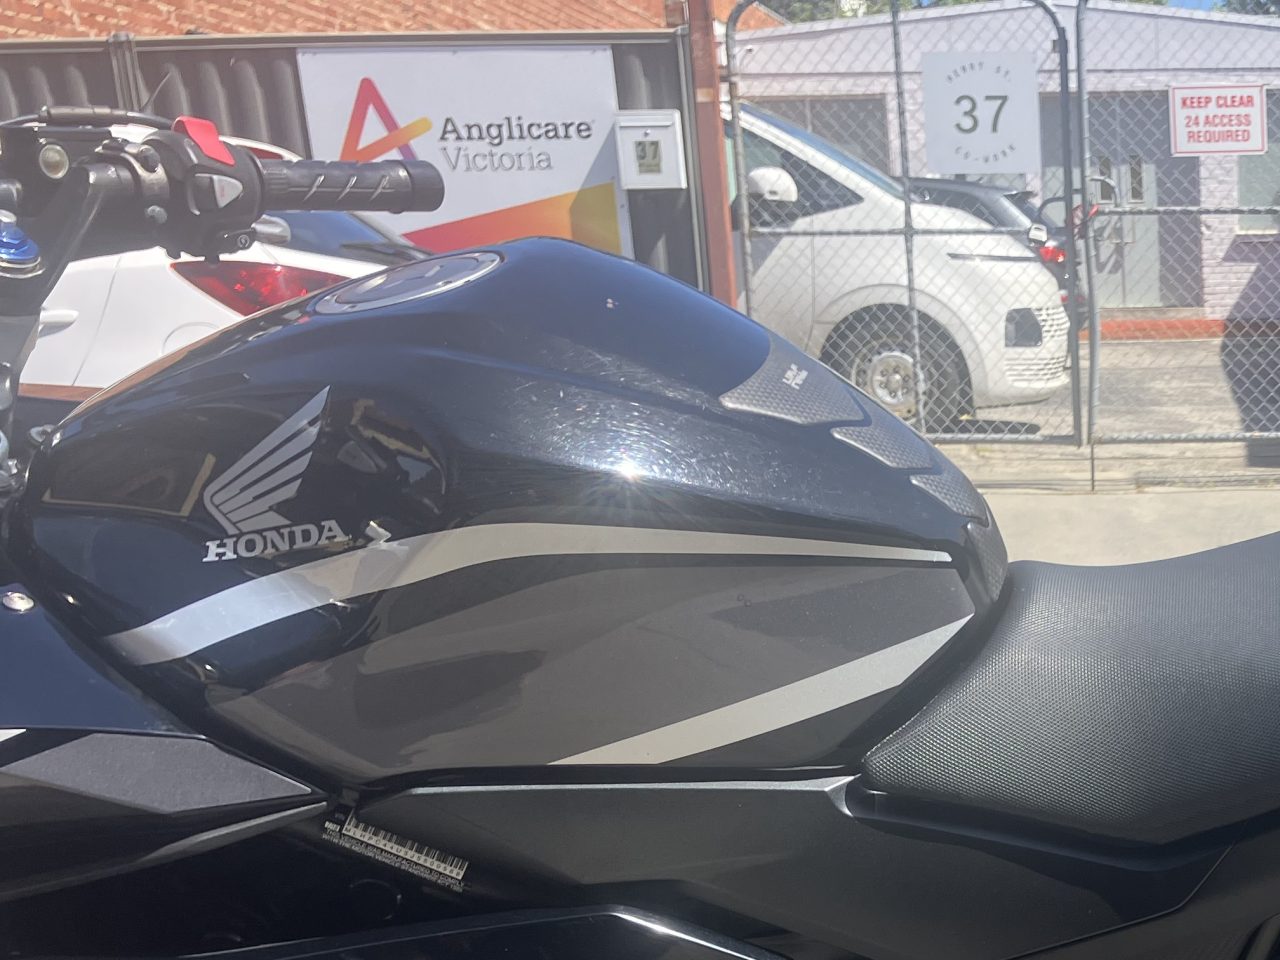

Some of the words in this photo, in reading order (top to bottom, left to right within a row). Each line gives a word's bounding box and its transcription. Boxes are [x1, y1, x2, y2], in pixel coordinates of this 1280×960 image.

[1180, 95, 1213, 109] KEEP
[1215, 94, 1255, 109] CLEAR
[954, 94, 1009, 134] 37
[1184, 115, 1200, 128] 24
[1203, 114, 1252, 128] ACCESS
[438, 116, 593, 147] Anglicare
[1187, 129, 1251, 144] REQUIRED
[440, 146, 554, 173] Victoria
[635, 140, 659, 161] 37
[202, 519, 353, 563] HONDA
